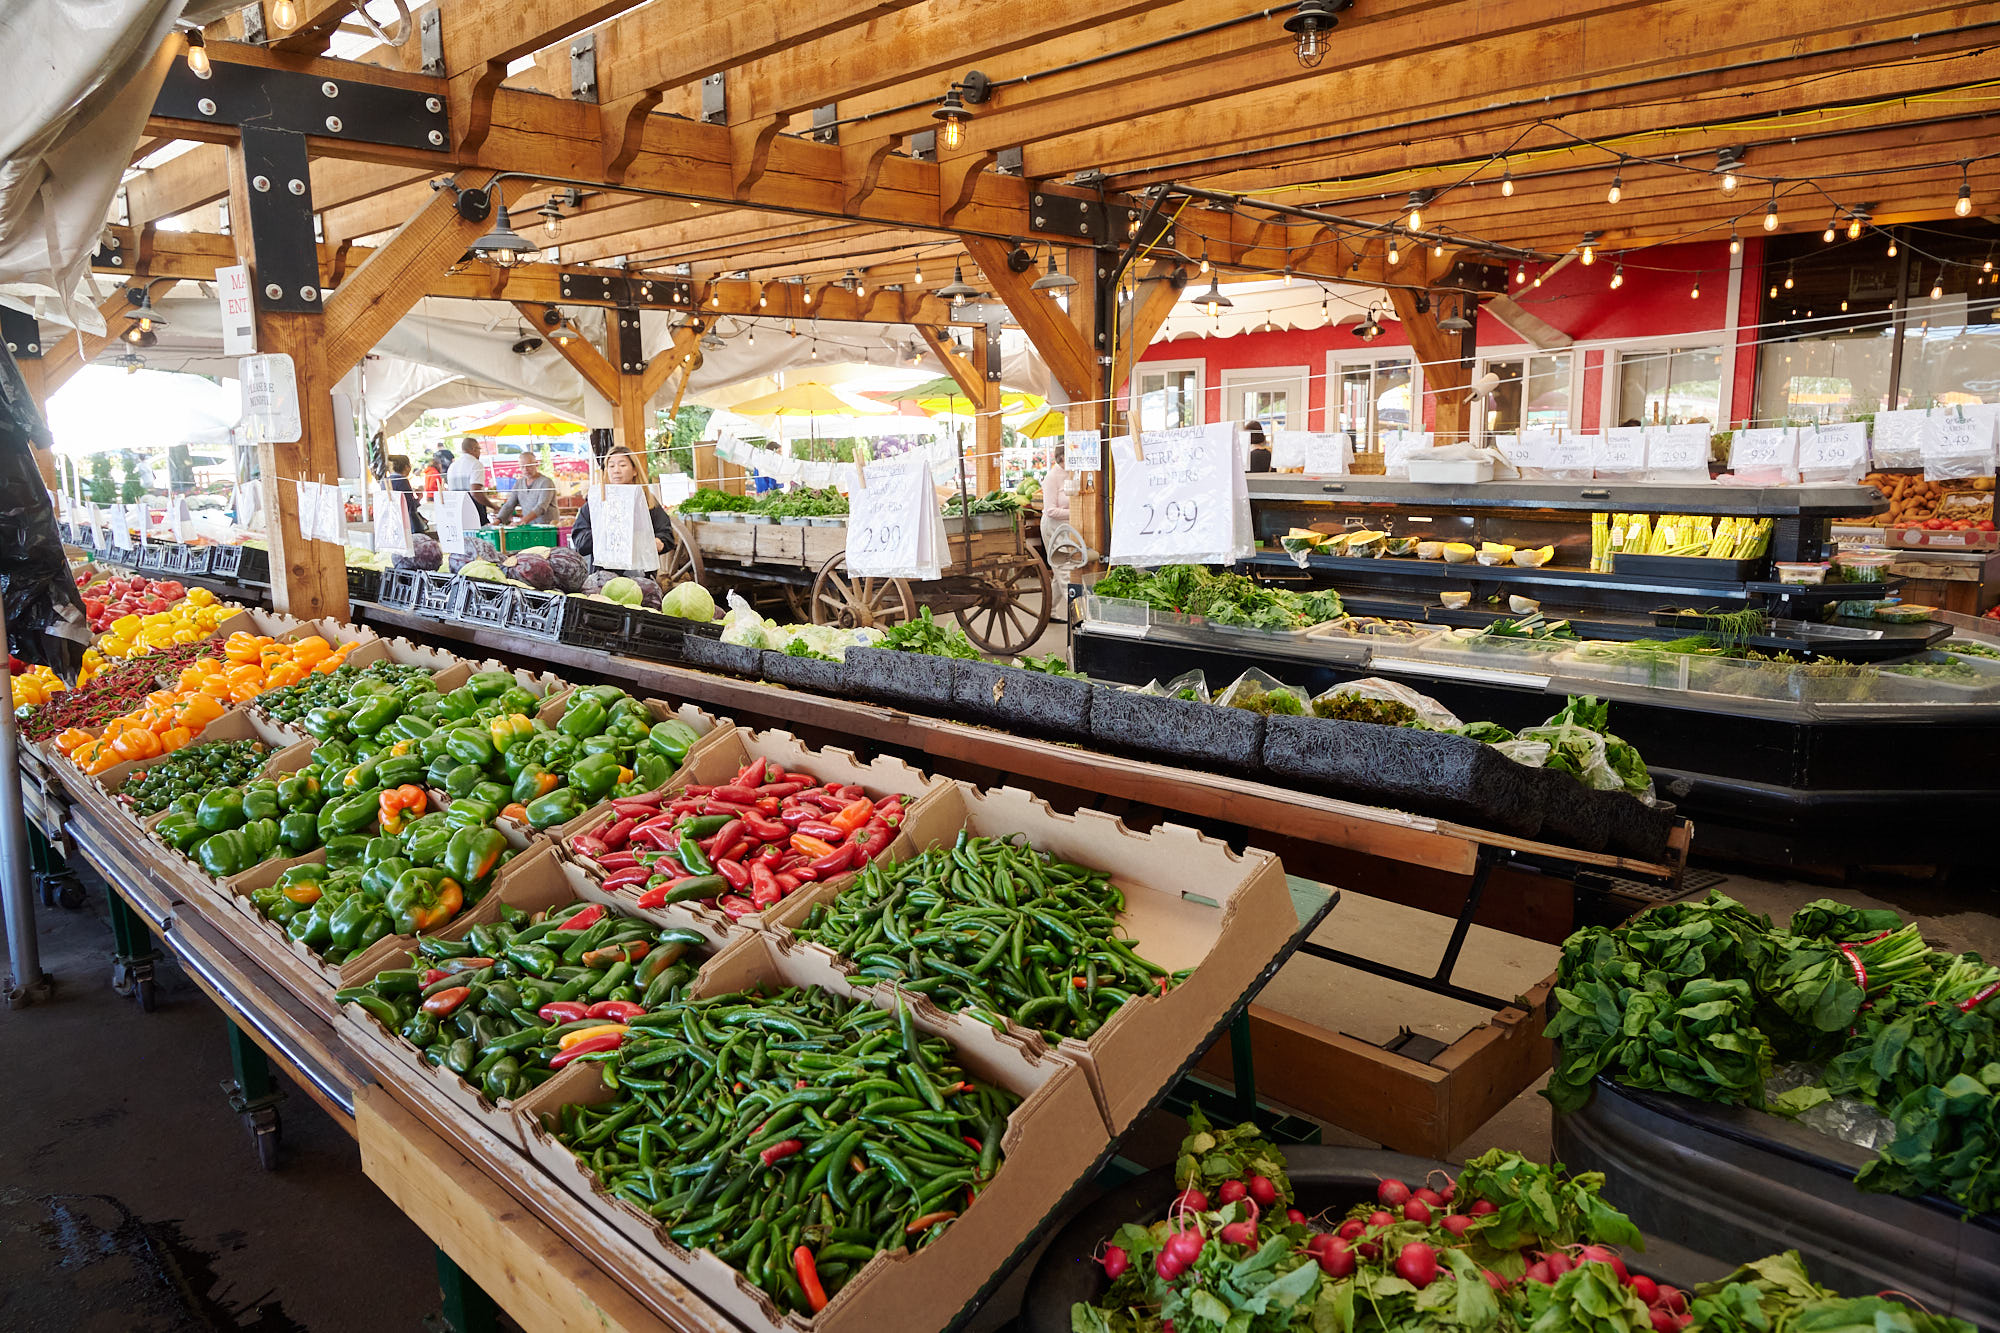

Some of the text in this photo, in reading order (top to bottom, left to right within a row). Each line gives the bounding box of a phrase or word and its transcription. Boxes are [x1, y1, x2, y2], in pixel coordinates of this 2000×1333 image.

[1145, 446, 1204, 466] SERRNO
[1140, 499, 1198, 535] 2.99
[862, 524, 902, 554] 2.99
